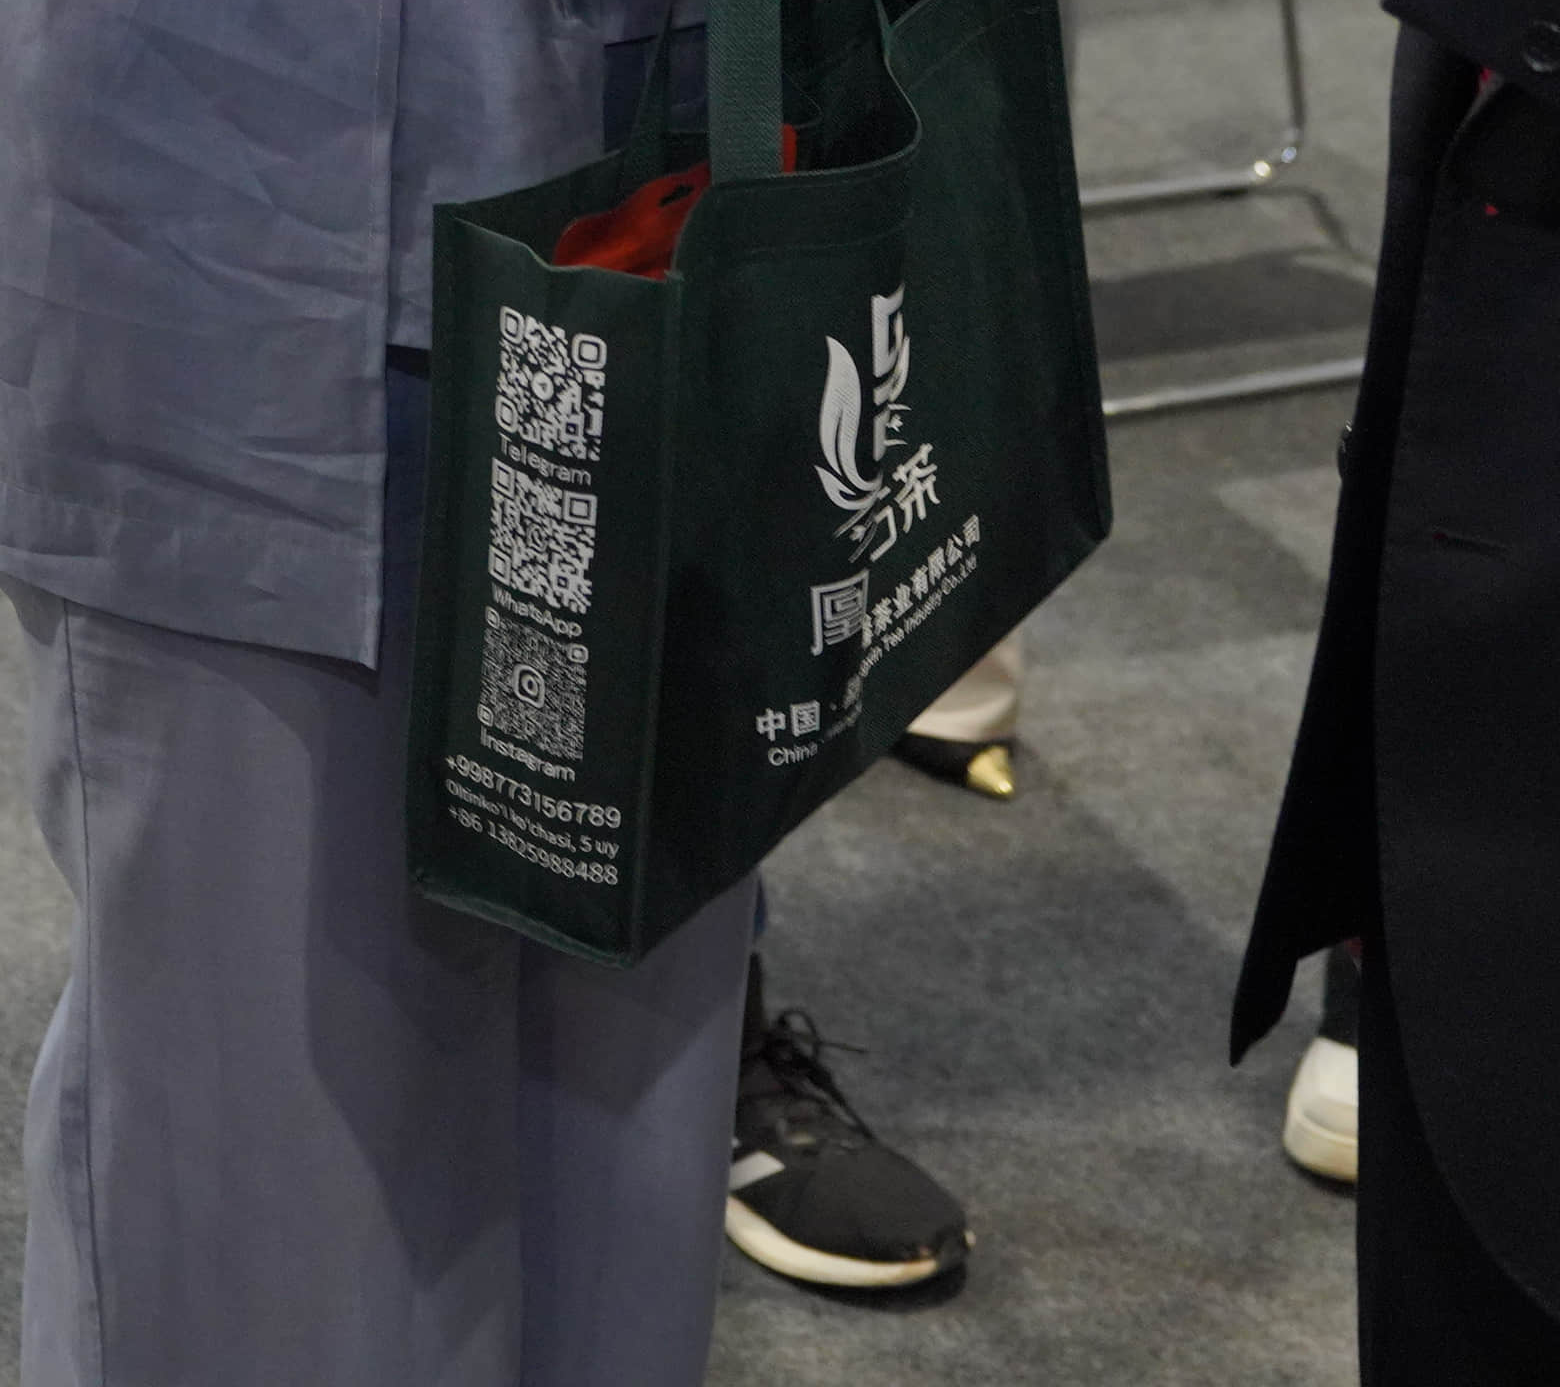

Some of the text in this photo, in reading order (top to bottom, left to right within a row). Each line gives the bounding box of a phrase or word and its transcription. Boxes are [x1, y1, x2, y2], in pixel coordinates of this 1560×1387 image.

[498, 430, 592, 487] Telegram
[491, 581, 583, 639] WhatsApp
[755, 699, 821, 742] 中国
[480, 728, 576, 782] Instagram
[767, 741, 819, 767] China
[444, 754, 622, 830] +998773156789
[448, 804, 485, 834] +86
[579, 834, 594, 854] 5
